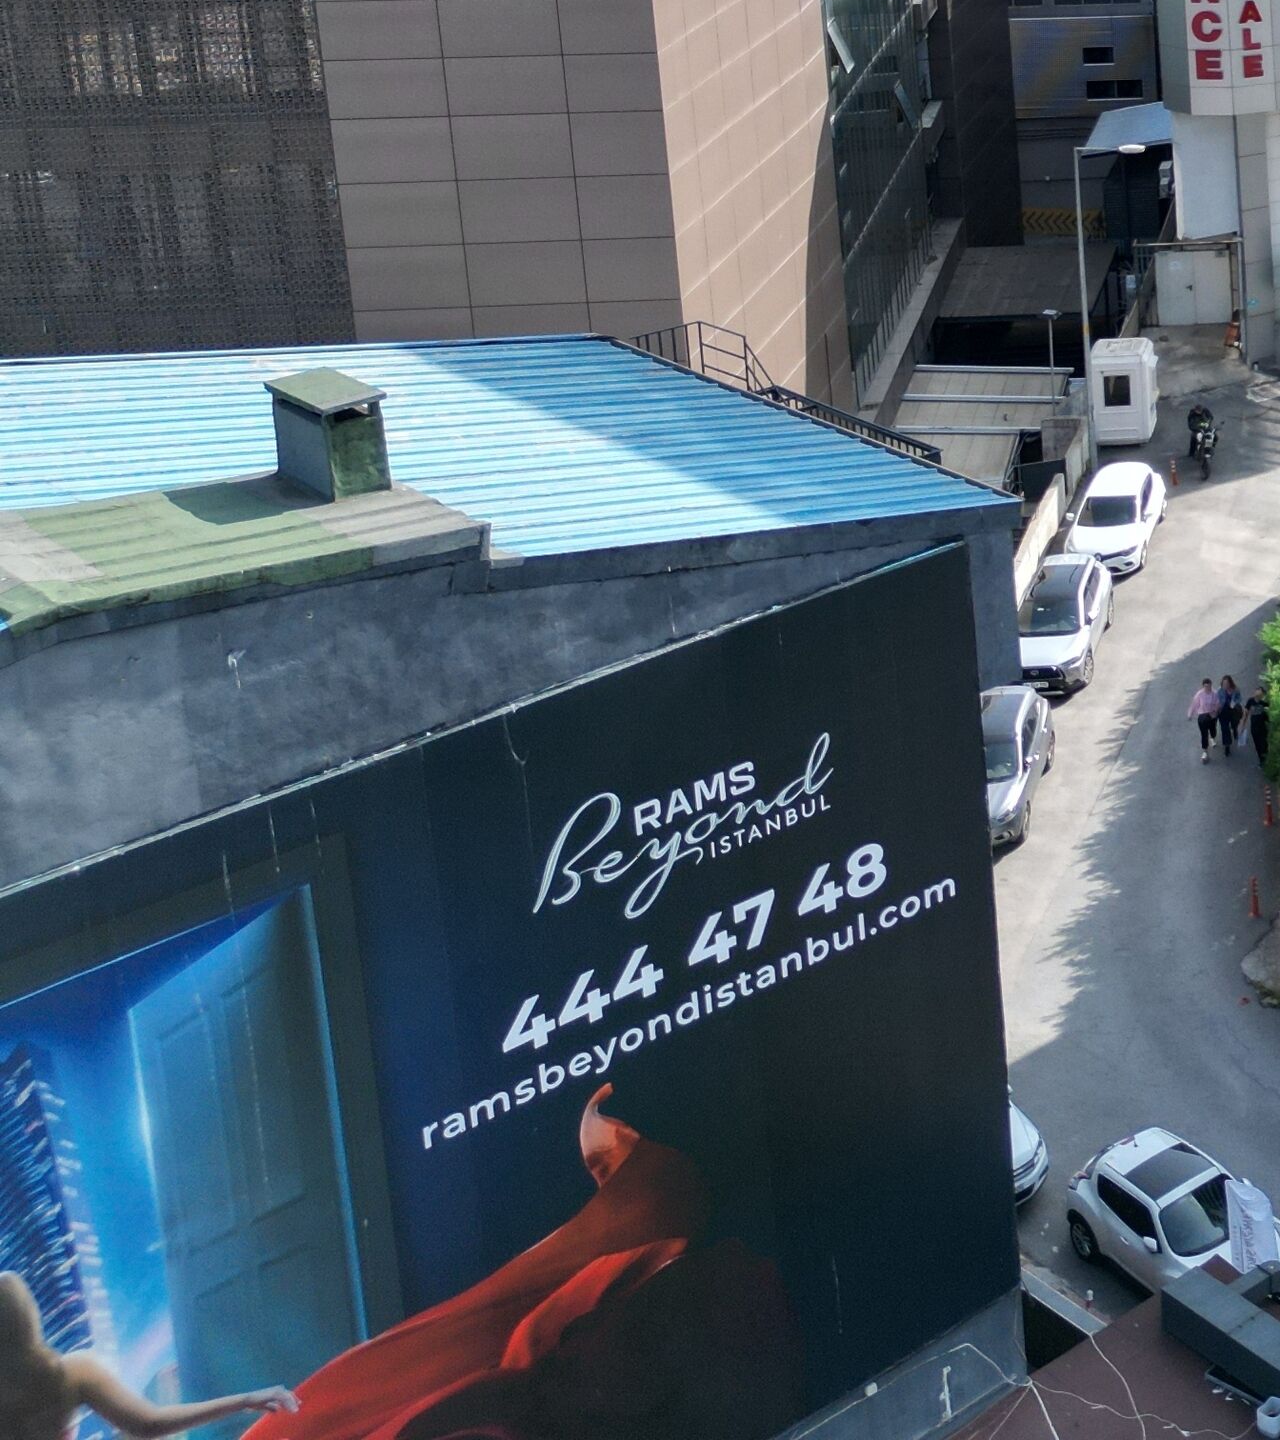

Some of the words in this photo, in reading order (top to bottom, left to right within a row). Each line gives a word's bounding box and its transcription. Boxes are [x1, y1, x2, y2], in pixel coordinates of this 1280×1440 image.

[532, 731, 835, 921] Beyond
[633, 760, 757, 837] RAMS
[710, 794, 832, 859] ISTANBUL
[420, 874, 958, 1151] ramsbeyondistanbul.com
[501, 943, 664, 1055] 444
[687, 889, 776, 972] 47
[796, 842, 888, 917] 48
